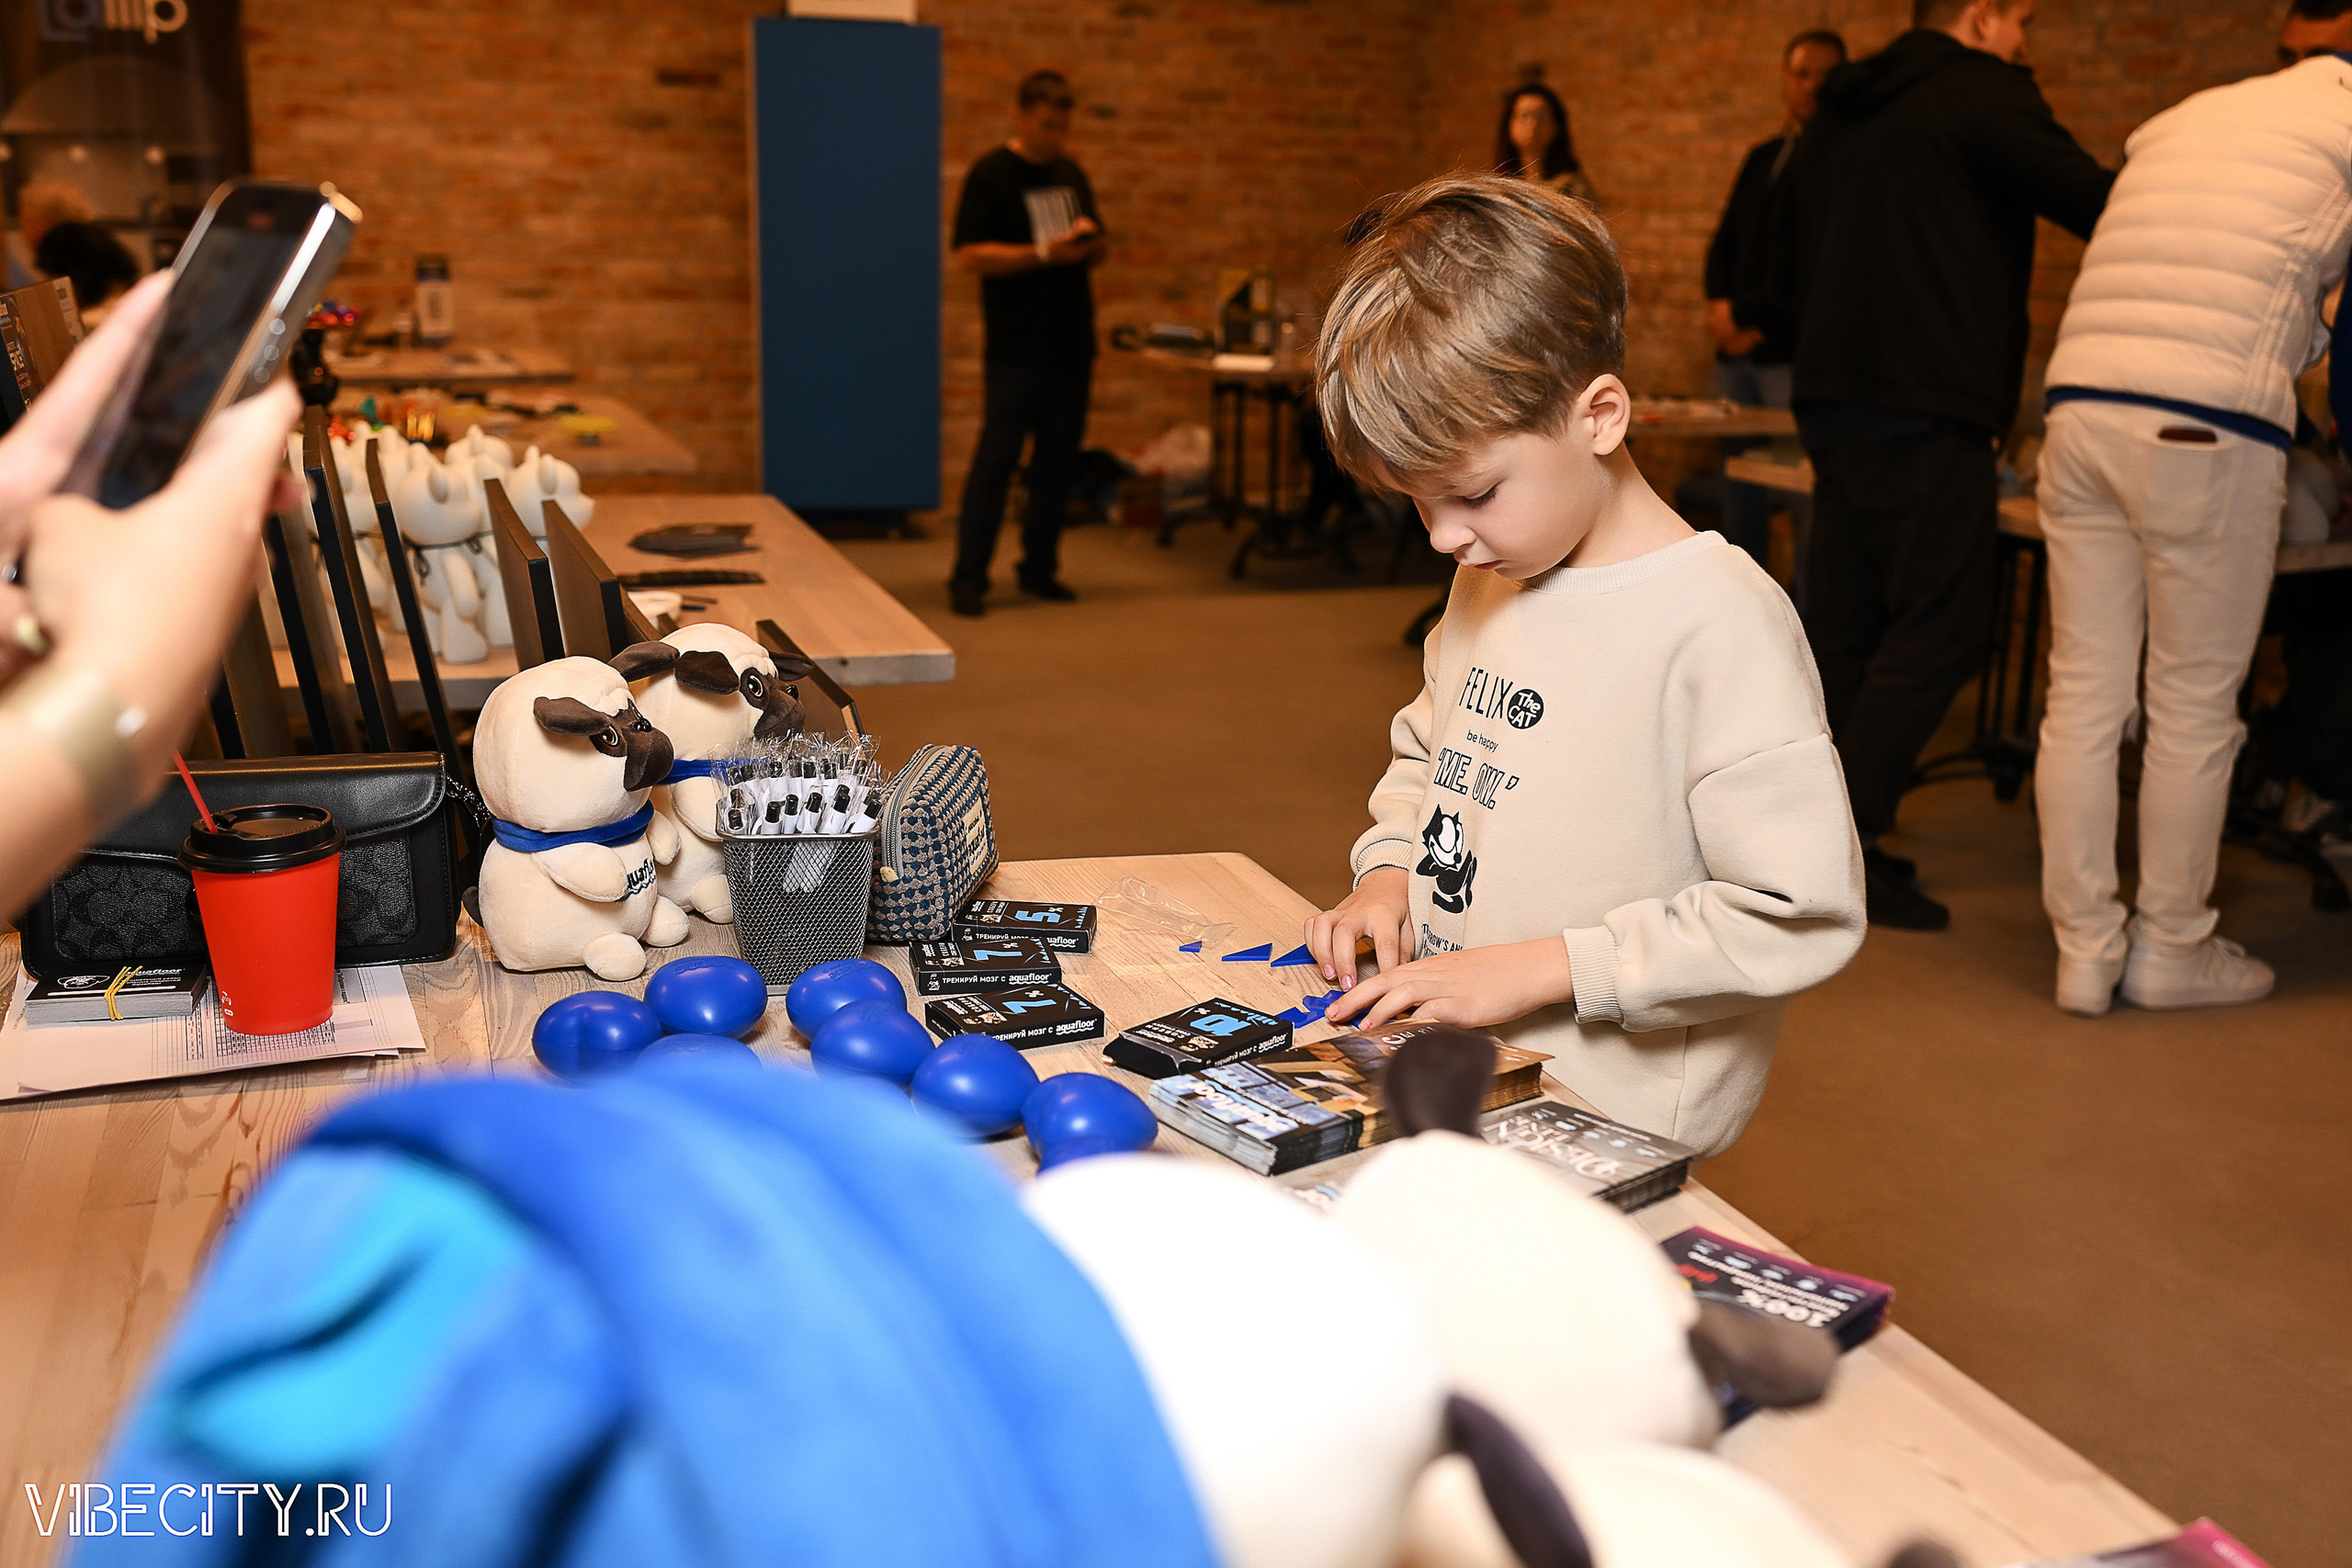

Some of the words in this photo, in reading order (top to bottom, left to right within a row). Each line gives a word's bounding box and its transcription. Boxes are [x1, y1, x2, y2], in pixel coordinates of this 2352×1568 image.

[1458, 666, 1514, 720] FELIX
[1518, 692, 1542, 714] The
[1508, 705, 1537, 728] CAT
[1466, 728, 1478, 743] be
[1478, 733, 1499, 753] happy
[1046, 936, 1077, 945] uafloor
[942, 975, 978, 984] ТРЕНИРУЙ
[979, 975, 1000, 983] МОЗГ
[1009, 972, 1049, 984] aquafloor
[1027, 1026, 1047, 1036] МОЗГ
[1056, 1019, 1095, 1034] aquafloor
[1238, 1045, 1253, 1057] МОЗГ
[1258, 1032, 1287, 1051] aquafloor
